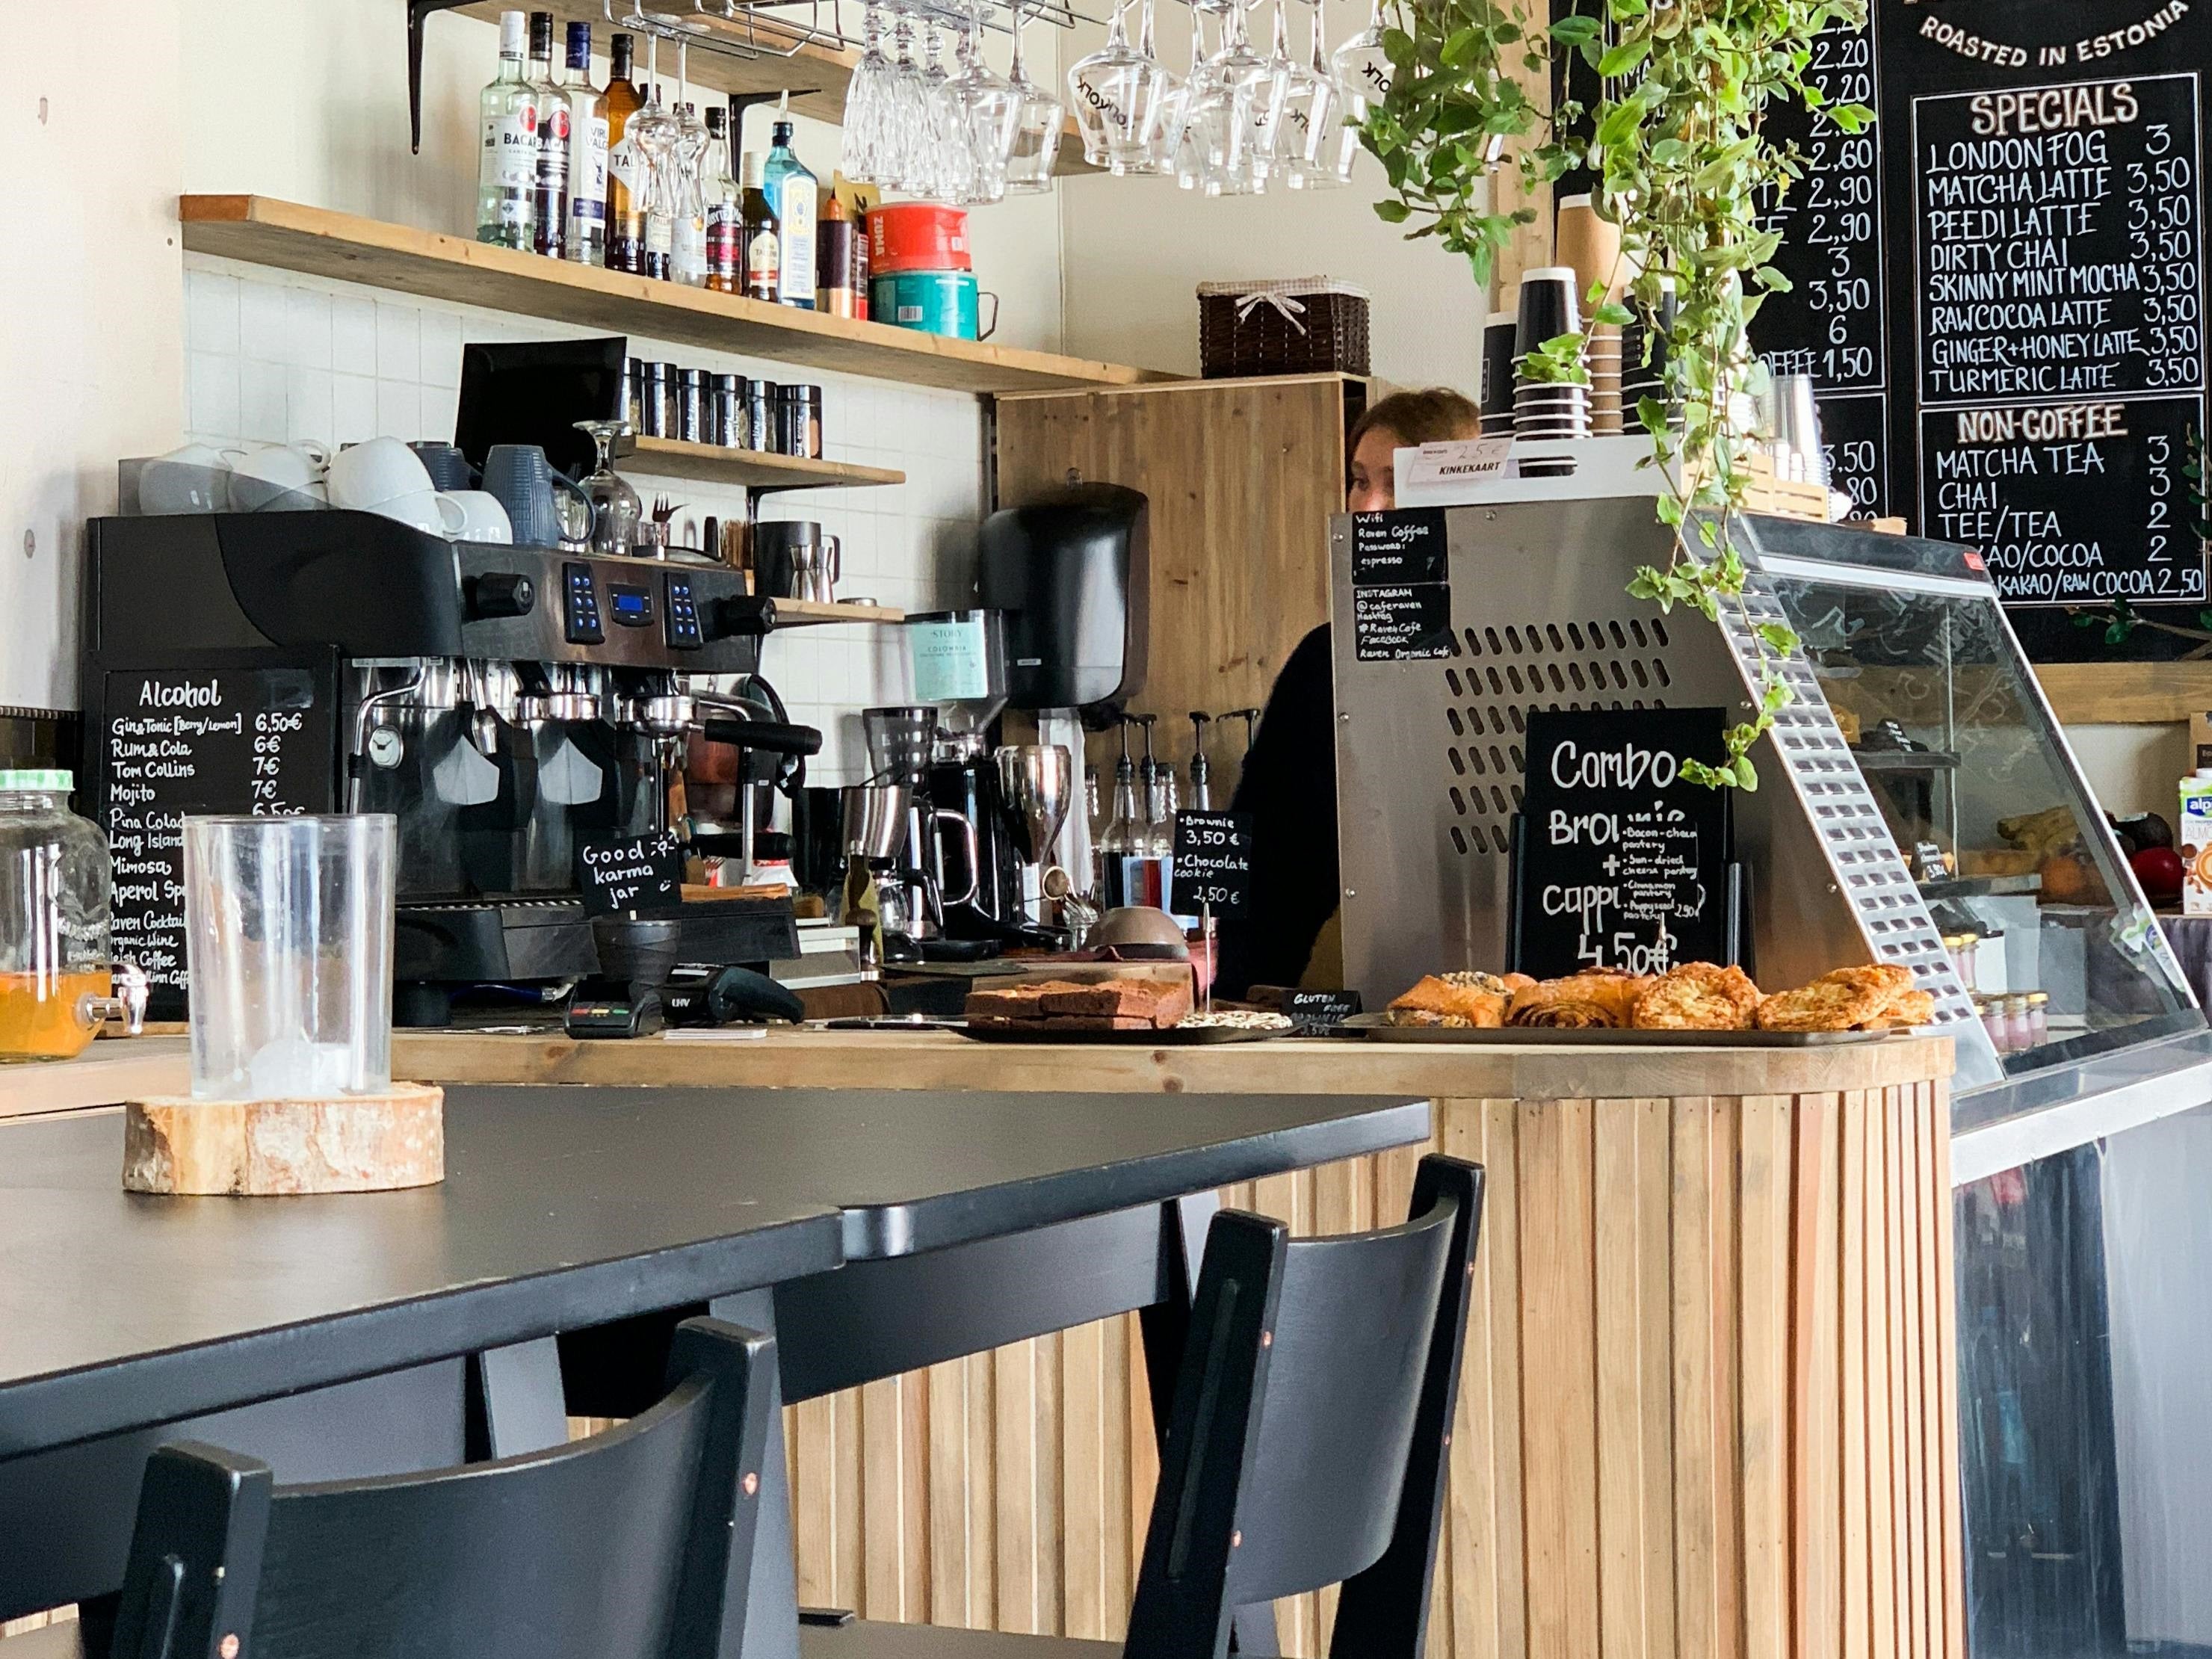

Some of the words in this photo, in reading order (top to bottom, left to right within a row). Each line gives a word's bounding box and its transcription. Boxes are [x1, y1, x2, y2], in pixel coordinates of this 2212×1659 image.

[1919, 16, 2027, 67] ROASTED
[2039, 46, 2066, 66] IN
[2077, 0, 2189, 61] ESTONIA
[1812, 39, 1868, 69] 2,20
[1816, 73, 1870, 106] 2,20
[1971, 83, 2139, 136] SPECIALS
[1808, 139, 1872, 172] 2,60
[1926, 136, 2043, 173] LONDON
[2043, 130, 2108, 166] FOG
[2145, 124, 2171, 155] 3
[1808, 176, 1872, 209] 2,90
[1927, 172, 2033, 206] MATCHA
[2036, 167, 2111, 203] LATTE
[2127, 157, 2190, 194] 3,50
[1808, 212, 1871, 245] 2,90
[1927, 208, 2006, 241] PEEDI
[2010, 203, 2101, 238] LATTE
[2128, 194, 2190, 230] 3,50
[874, 216, 886, 256] ZUMA
[1931, 243, 2001, 271] DIRTY
[2007, 238, 2068, 270] CHAI
[2130, 230, 2191, 262] 3,50
[1828, 247, 1850, 277] 3
[1809, 278, 1870, 313] 3,50
[1930, 272, 2007, 301] SKINNY
[2013, 268, 2066, 297] MINT
[2070, 262, 2140, 294] MOCHA
[2143, 262, 2196, 294] 3,50
[2052, 300, 2112, 328] LATTE
[2143, 294, 2196, 324] 3,50
[1829, 315, 1847, 345] 6
[2093, 328, 2150, 356] LATTE
[2151, 326, 2197, 356] 3,50
[1823, 347, 1873, 382] 1,50
[1929, 366, 2057, 392] TURMERIC
[2060, 362, 2120, 388] LATTE
[2146, 357, 2199, 386] 3,50
[1957, 404, 2128, 444] NON-COFFEE
[1439, 462, 1501, 475] KINKEKAART
[1936, 447, 2037, 478] MATCHA
[2043, 442, 2104, 475] TEA
[2148, 435, 2169, 464] 3
[1938, 481, 1997, 510] CHAI
[2150, 468, 2170, 495] 3
[1358, 528, 1386, 538] Raven
[1391, 525, 1429, 542] Coffee
[1938, 505, 2061, 542] TEE/TEA
[2147, 502, 2171, 529] 2
[1361, 557, 1403, 568] espresso
[2148, 536, 2172, 561] 2
[1356, 589, 1412, 599] INSTAGRAM
[2093, 569, 2153, 596] COCOA
[2157, 569, 2202, 595] 2,50
[139, 679, 222, 708] Alcohol
[254, 735, 281, 753] 6€
[111, 761, 141, 779] Tom
[145, 760, 195, 778] Collins
[253, 756, 280, 776] 7€
[1551, 740, 1676, 789] Combo
[110, 782, 155, 806] Mojito
[251, 779, 276, 799] 7€
[2189, 797, 2212, 812] alp
[146, 811, 185, 829] Colad
[1186, 815, 1234, 829] Brownie
[110, 830, 143, 856] Long
[583, 840, 644, 865] Good
[110, 856, 172, 875] Mimosa
[594, 865, 653, 885] karma
[1174, 868, 1214, 878] cookie
[1184, 854, 1249, 871] Chocolate
[111, 880, 159, 907] Aperol
[610, 888, 639, 909] jar
[111, 934, 146, 953] rganic
[147, 931, 179, 947] Wine
[140, 950, 176, 970] Coffee
[671, 998, 691, 1007] LHV
[1294, 993, 1335, 1004] GLUTEN
